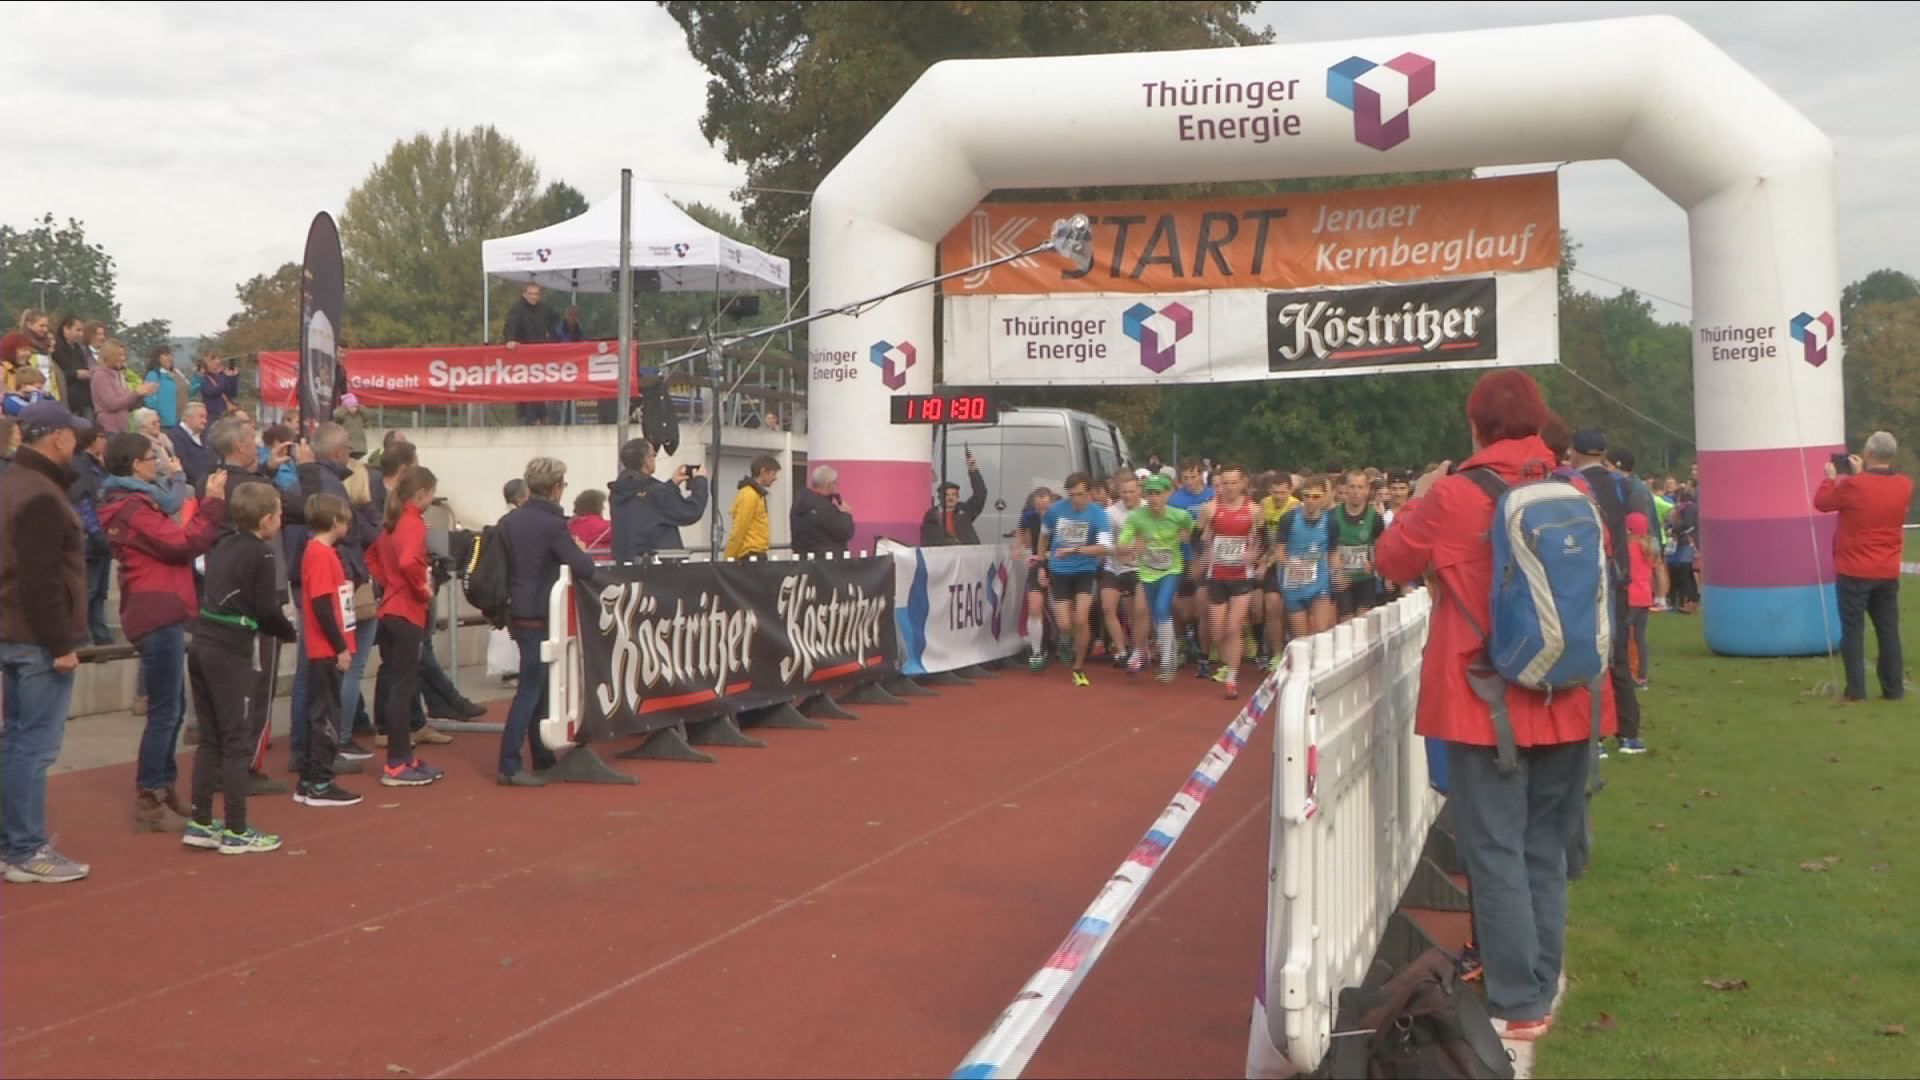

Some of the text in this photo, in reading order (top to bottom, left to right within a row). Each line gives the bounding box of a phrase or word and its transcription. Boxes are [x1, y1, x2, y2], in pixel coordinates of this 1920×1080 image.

[1142, 77, 1300, 109] Thüringer
[1179, 109, 1301, 143] Energie
[1312, 203, 1422, 234] Jenaer
[1315, 223, 1537, 272] Kernberglauf
[1002, 315, 1106, 338] Thüringer
[1278, 300, 1486, 360] Köstritzer
[1699, 325, 1776, 344] Thüringer
[1026, 338, 1107, 363] Energie
[1712, 342, 1777, 362] Energie
[386, 374, 419, 390] geht
[428, 358, 578, 392] Sparkasse
[812, 365, 858, 382] Energie
[948, 583, 984, 631] TEAG
[779, 575, 886, 683] Köstritzer
[597, 581, 758, 717] Köstritzer
